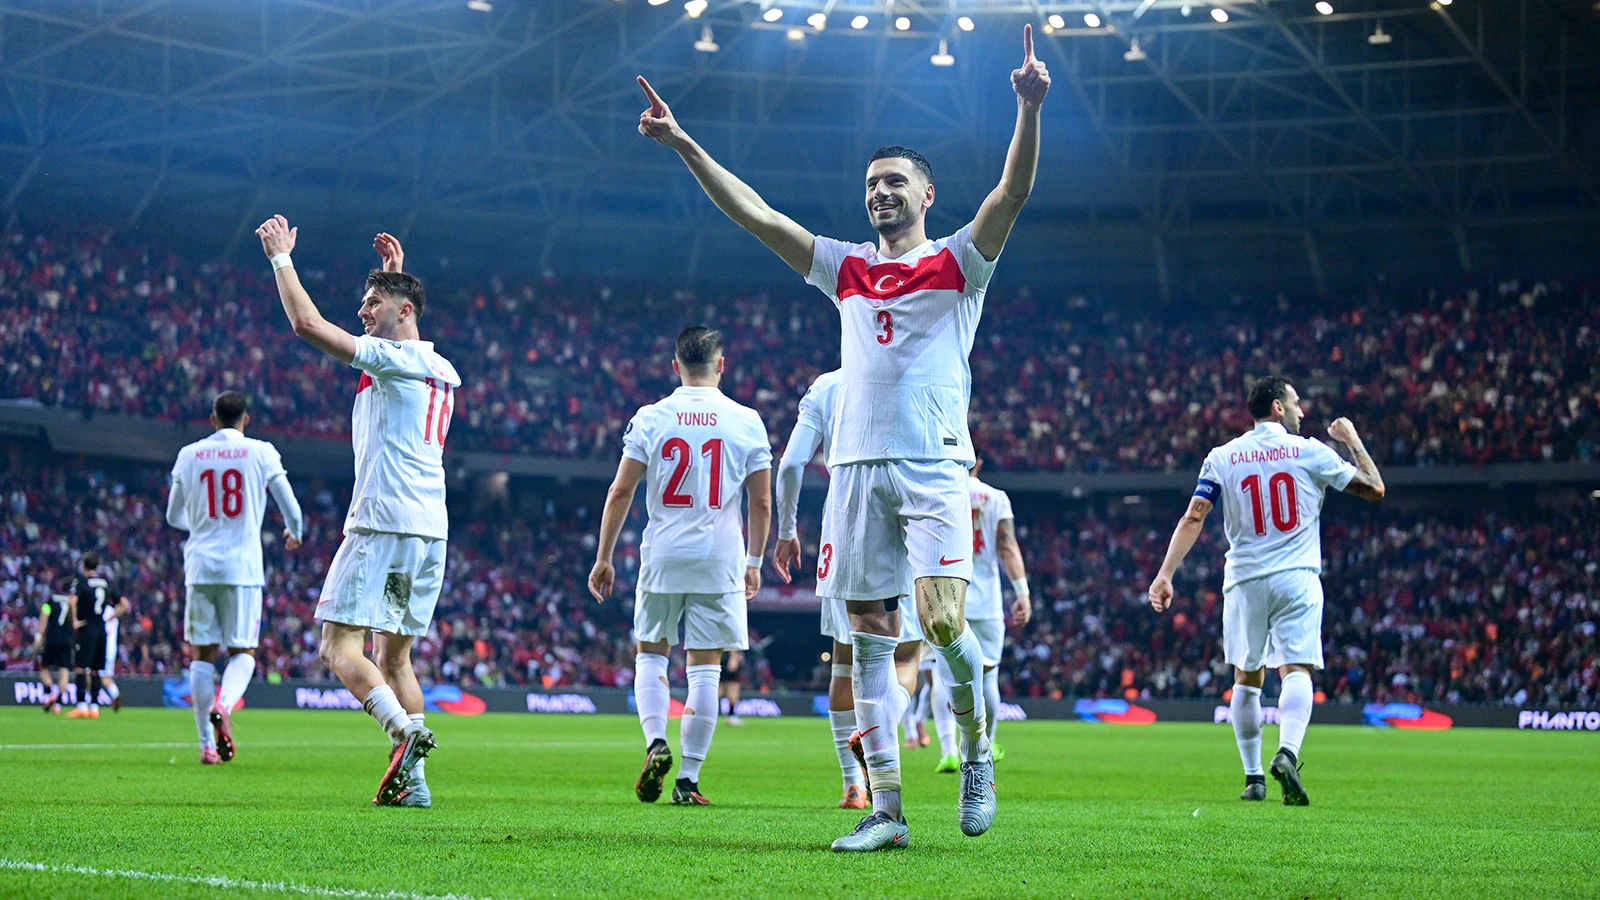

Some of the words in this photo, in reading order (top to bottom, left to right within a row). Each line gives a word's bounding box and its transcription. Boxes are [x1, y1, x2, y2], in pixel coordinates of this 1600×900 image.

[876, 310, 894, 346] 3
[424, 376, 451, 450] 16
[676, 411, 718, 427] YUNUS
[199, 467, 244, 520] 18
[661, 437, 724, 510] 21
[1240, 471, 1300, 537] 10
[817, 542, 833, 582] 3
[1518, 710, 1600, 731] PHANTO
